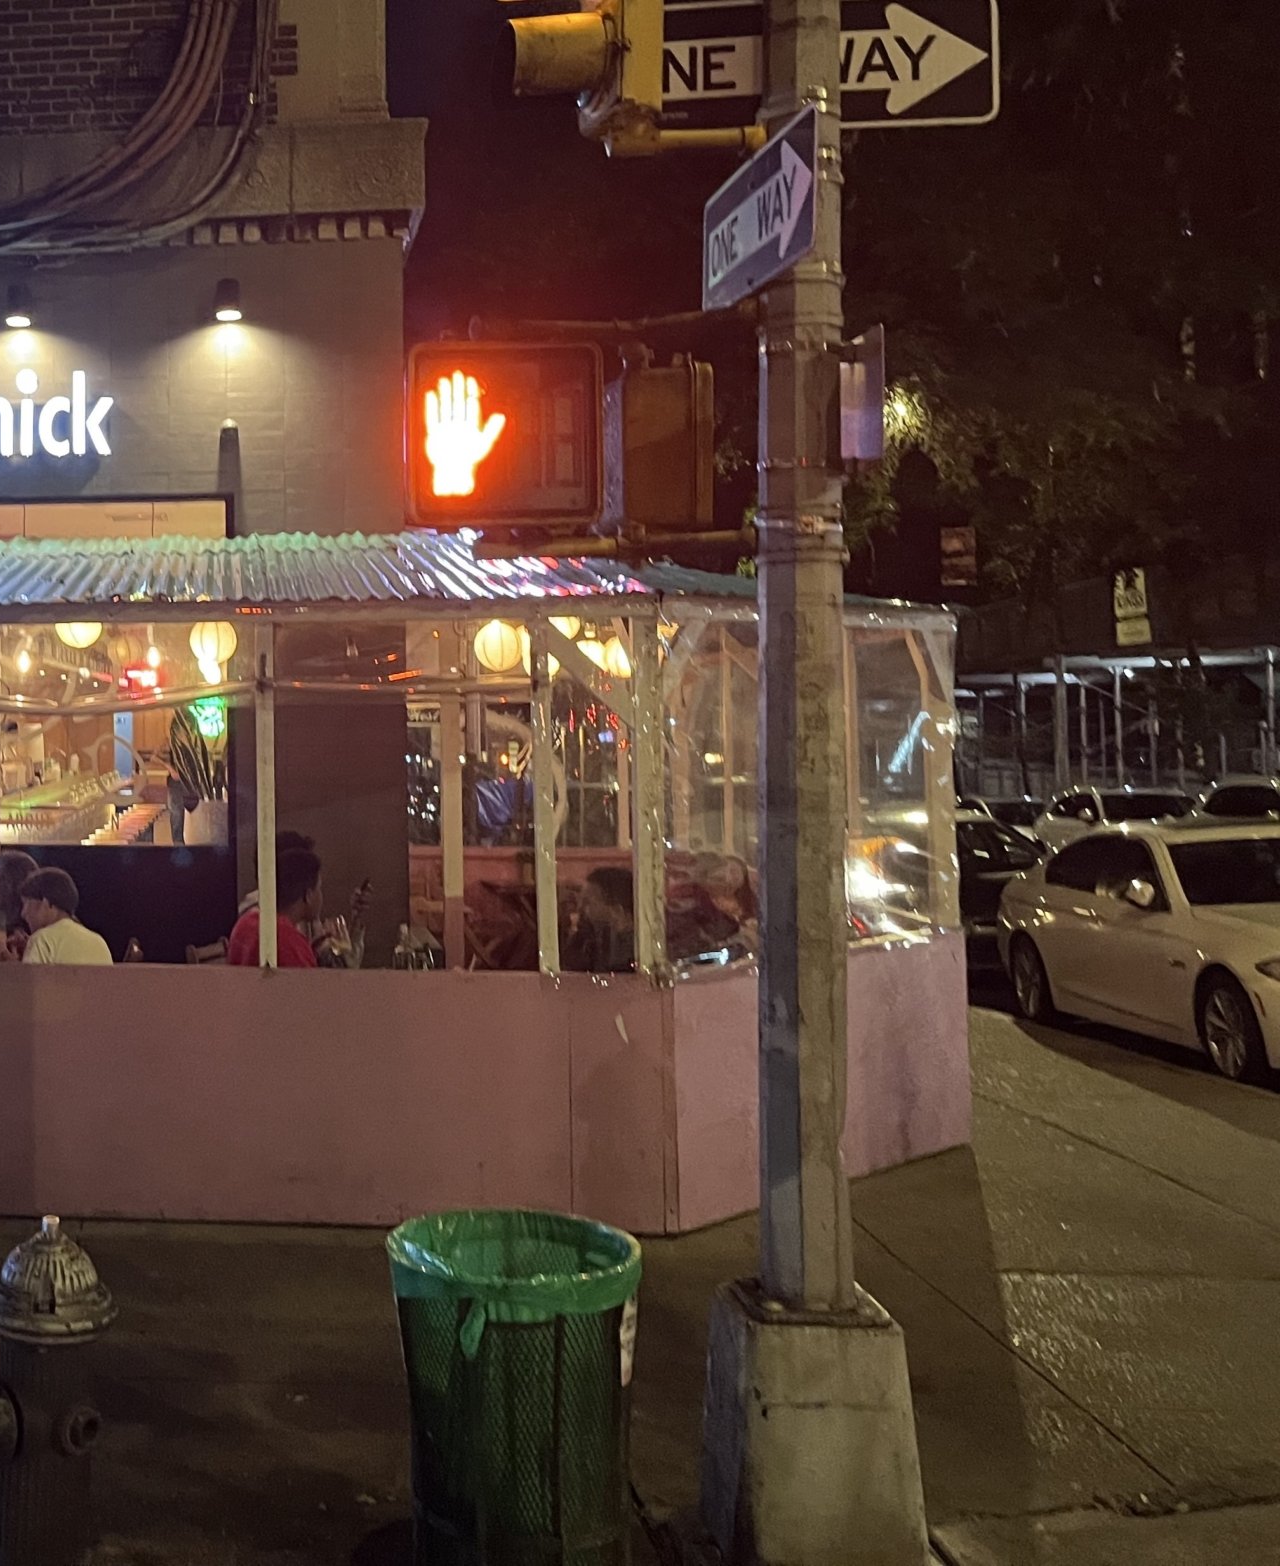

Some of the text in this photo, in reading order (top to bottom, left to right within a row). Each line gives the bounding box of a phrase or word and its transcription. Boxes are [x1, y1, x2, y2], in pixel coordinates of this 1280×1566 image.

[663, 34, 936, 93] NE AY
[711, 164, 797, 278] ONE WAY
